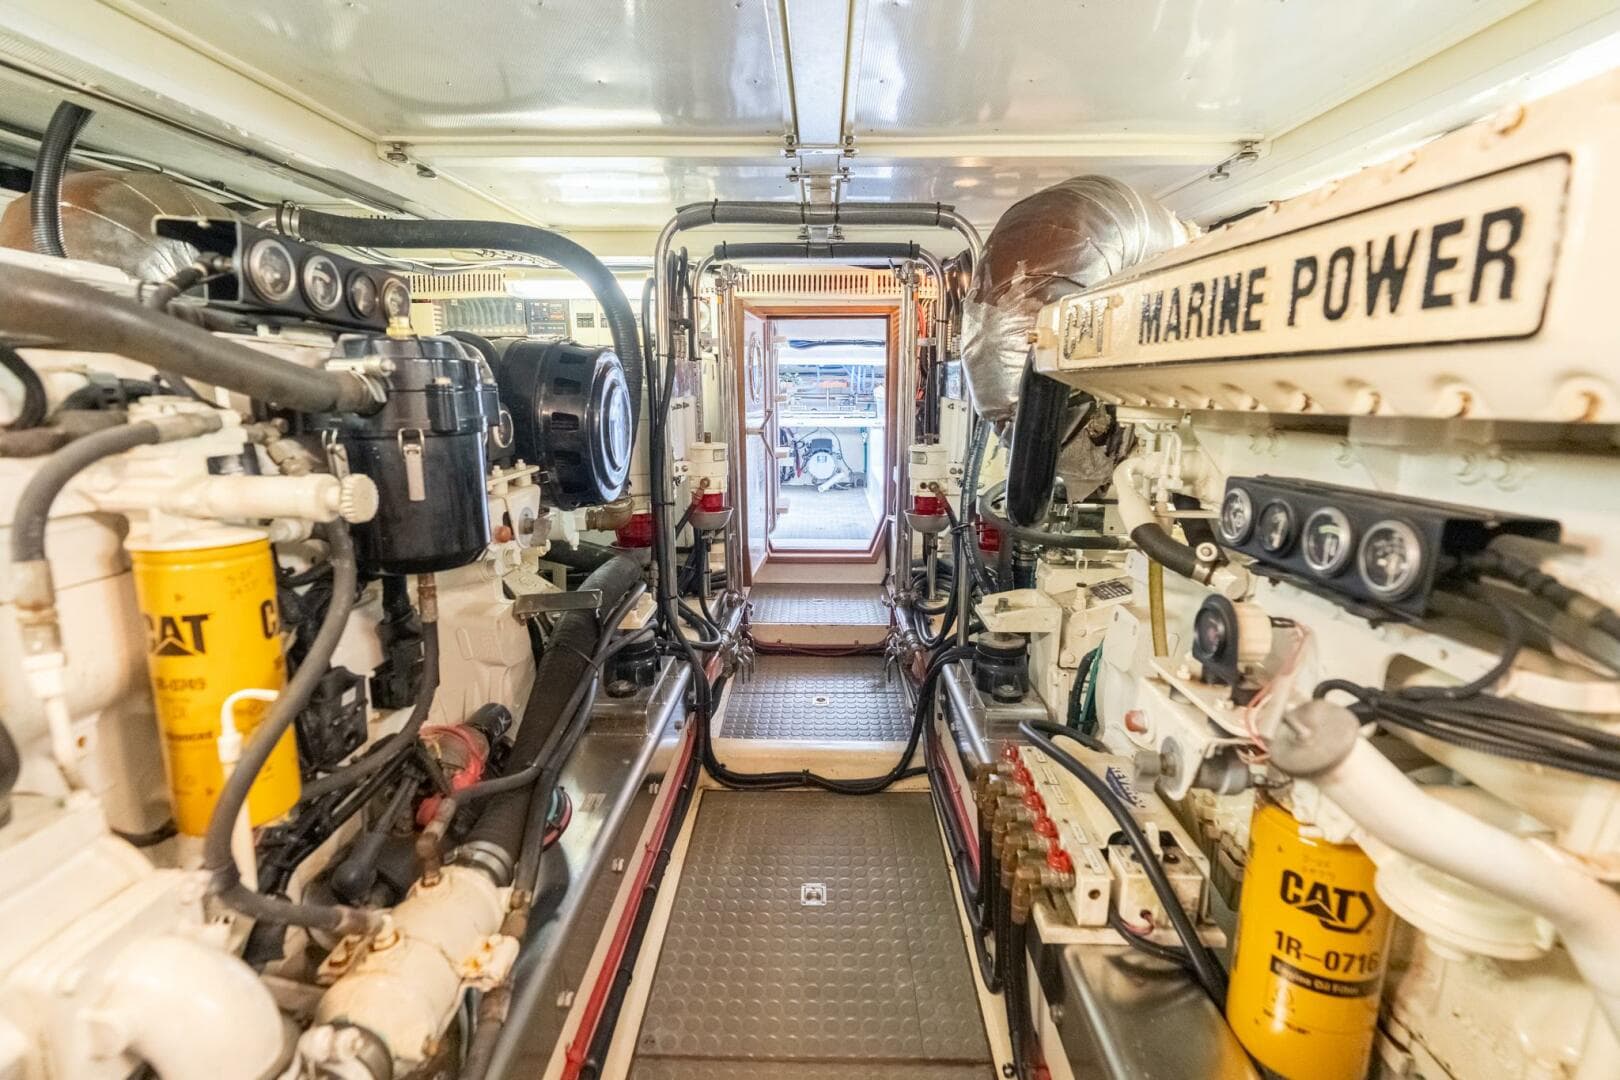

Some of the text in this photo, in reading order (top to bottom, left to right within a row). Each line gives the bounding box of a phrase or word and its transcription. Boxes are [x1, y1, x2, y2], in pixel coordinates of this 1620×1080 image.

[1138, 267, 1267, 346] MARINE
[1287, 206, 1526, 326] POWER
[1280, 869, 1358, 923] CAT
